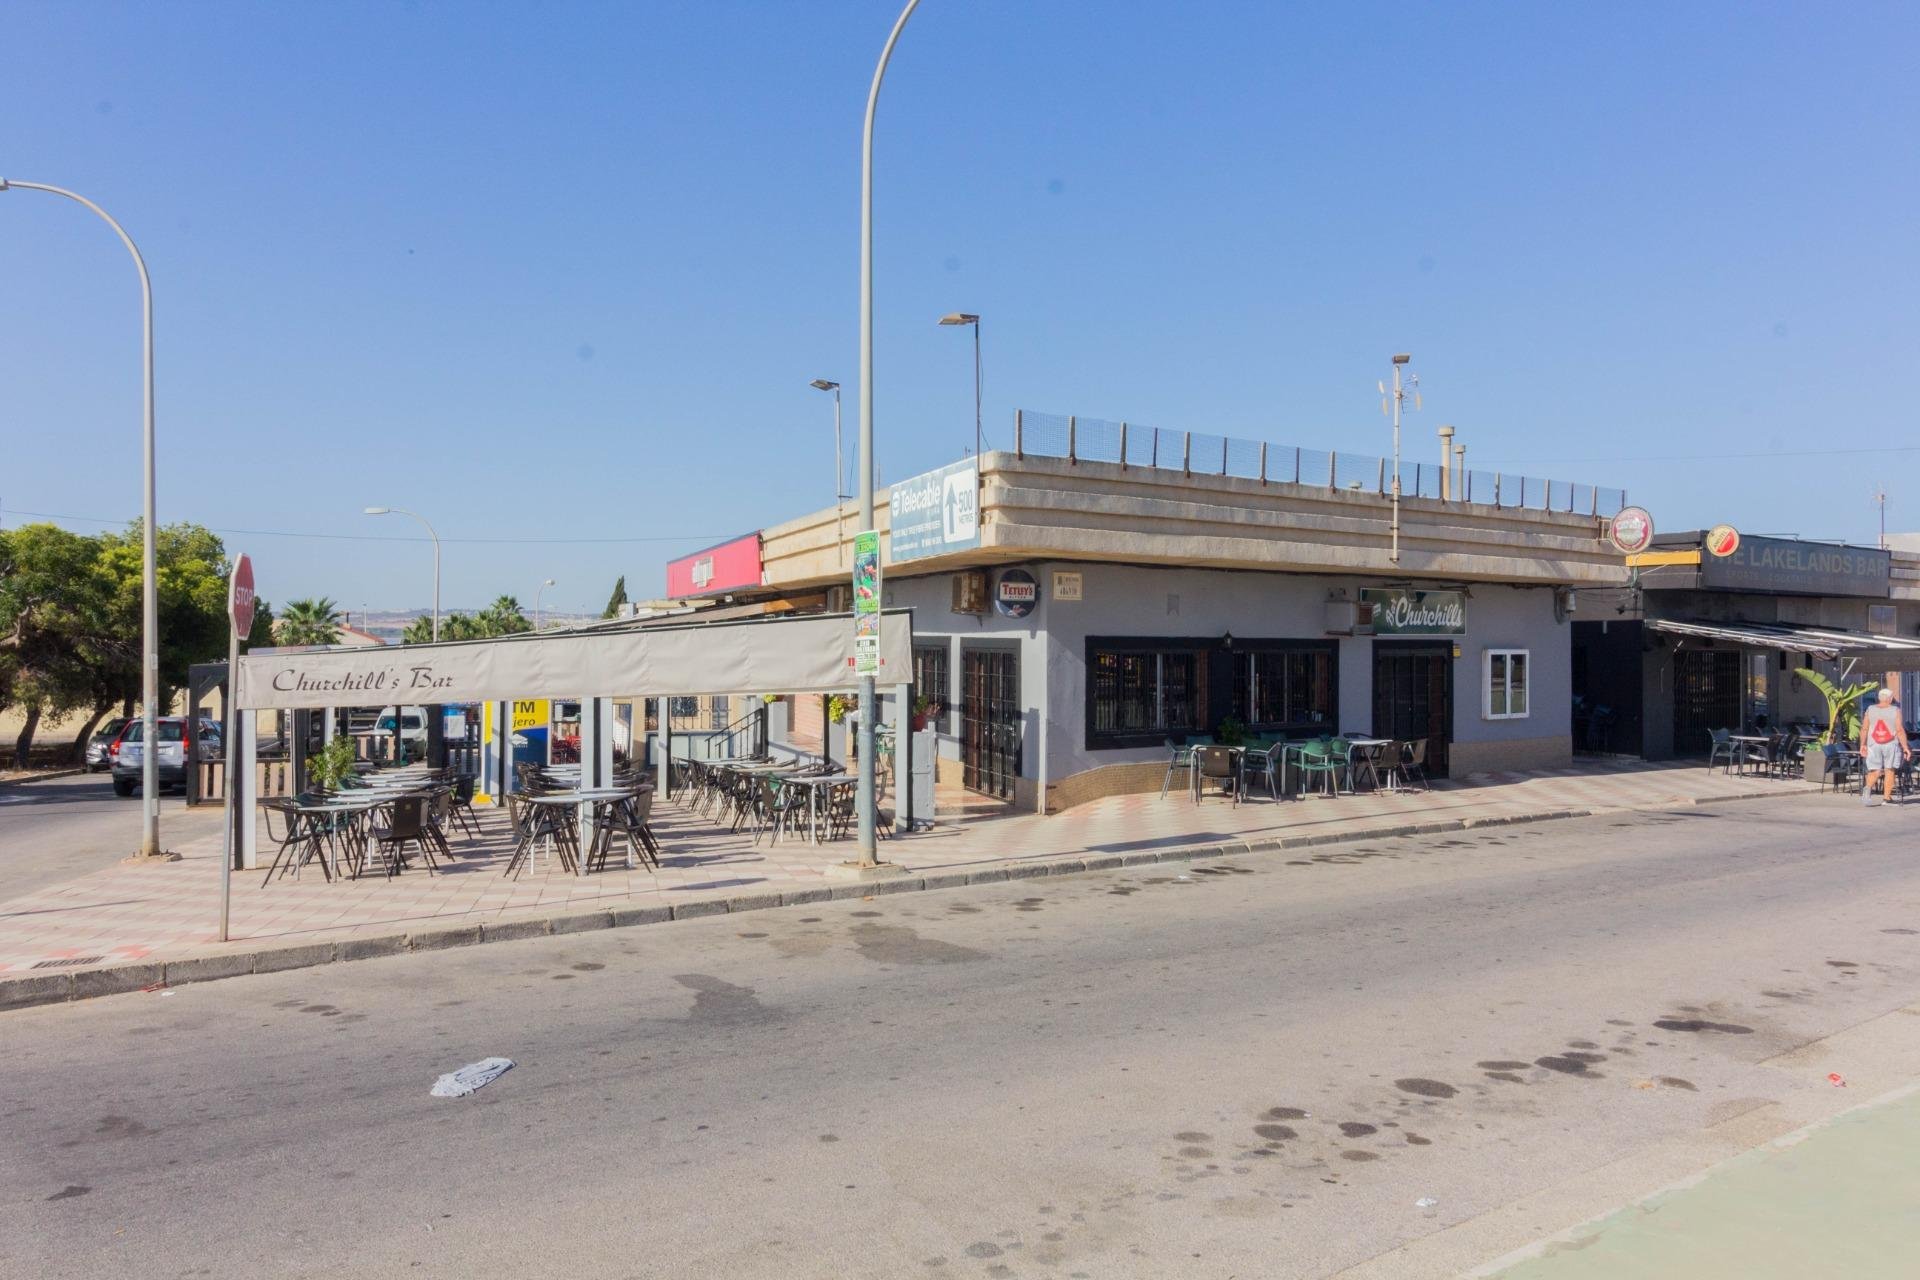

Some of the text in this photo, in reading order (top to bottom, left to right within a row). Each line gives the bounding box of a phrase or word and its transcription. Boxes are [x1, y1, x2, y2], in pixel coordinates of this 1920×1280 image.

[901, 481, 941, 513] Telecable
[958, 489, 973, 512] 500
[1751, 547, 1852, 574] LAKELANDS
[1856, 556, 1886, 577] BAR
[236, 586, 253, 607] STOP
[1395, 597, 1463, 628] Churchills
[272, 667, 455, 692] Churchill's Bar
[513, 701, 536, 714] TM
[513, 717, 536, 727] jero
